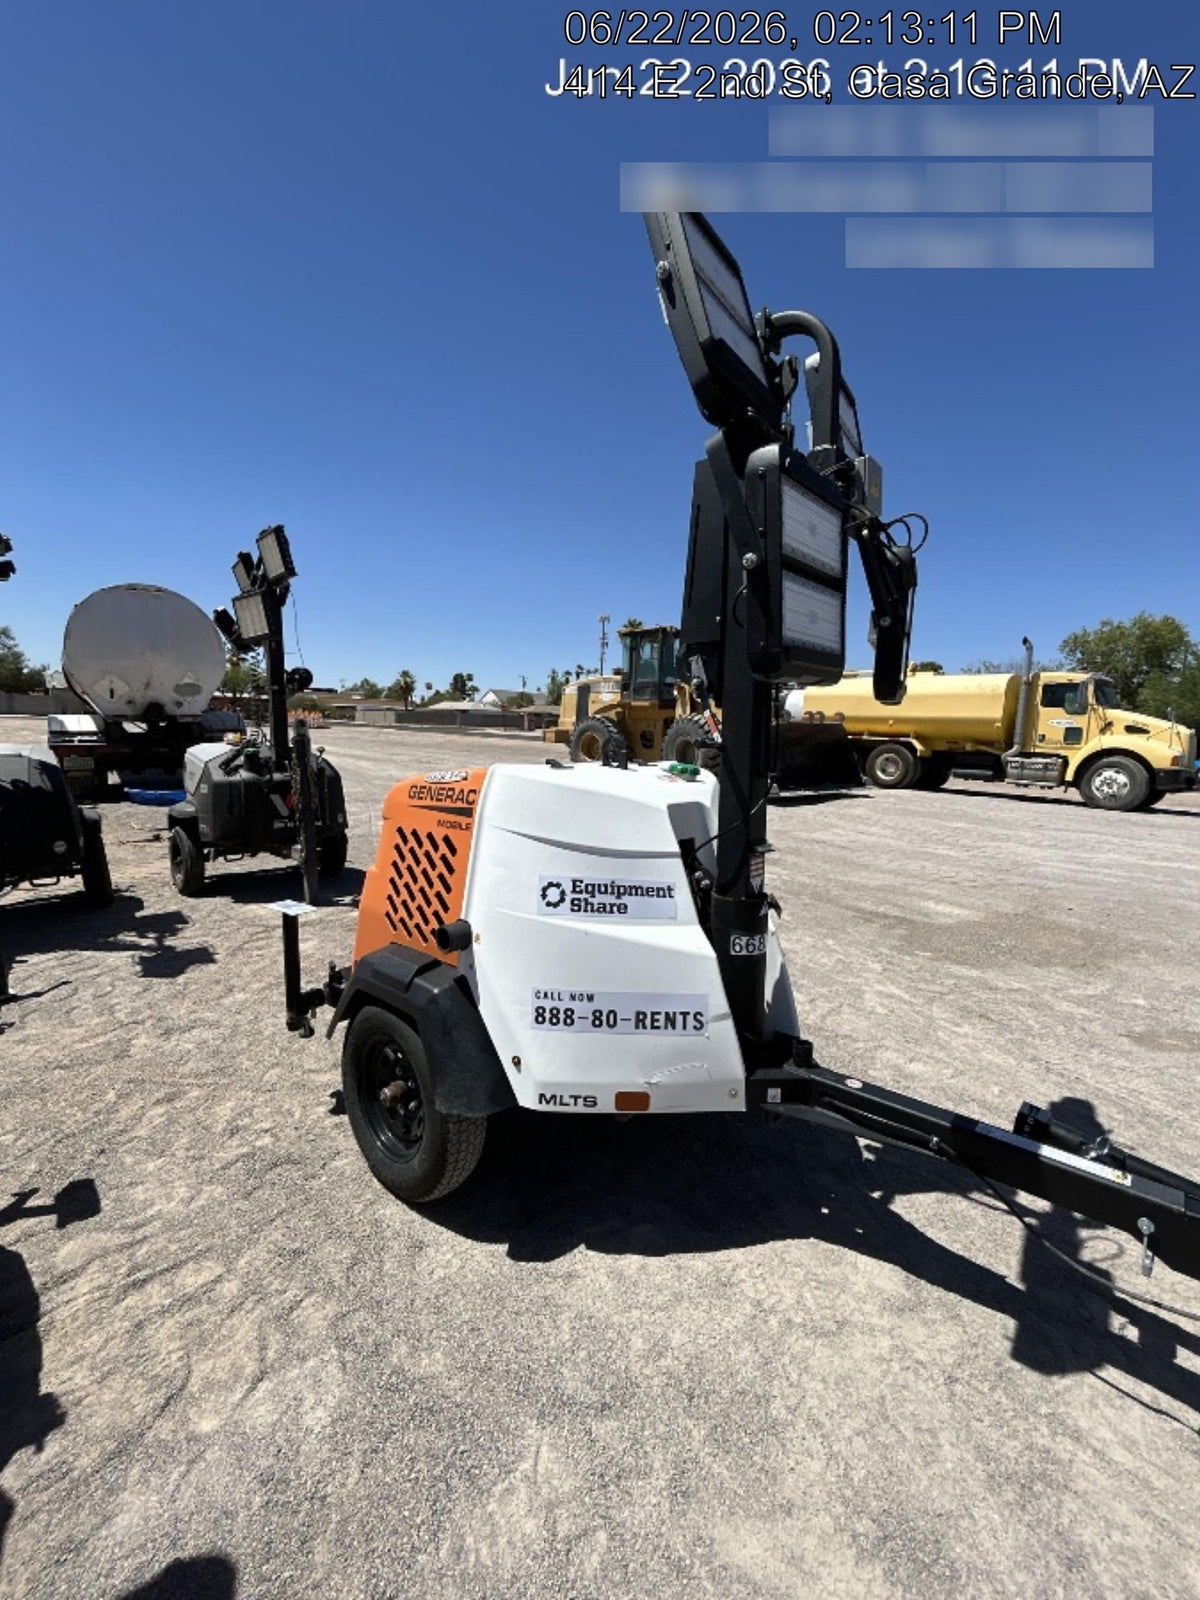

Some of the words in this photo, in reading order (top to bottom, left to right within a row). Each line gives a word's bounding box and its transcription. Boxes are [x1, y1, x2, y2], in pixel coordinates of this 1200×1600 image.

[408, 785, 477, 806] GENERAC
[570, 879, 675, 899] Equipment
[570, 897, 628, 915] Share
[534, 989, 564, 1002] CALL
[569, 992, 595, 1002] NOW
[534, 1005, 705, 1032] 888-80-RENTS
[538, 1092, 599, 1109] MLTS
